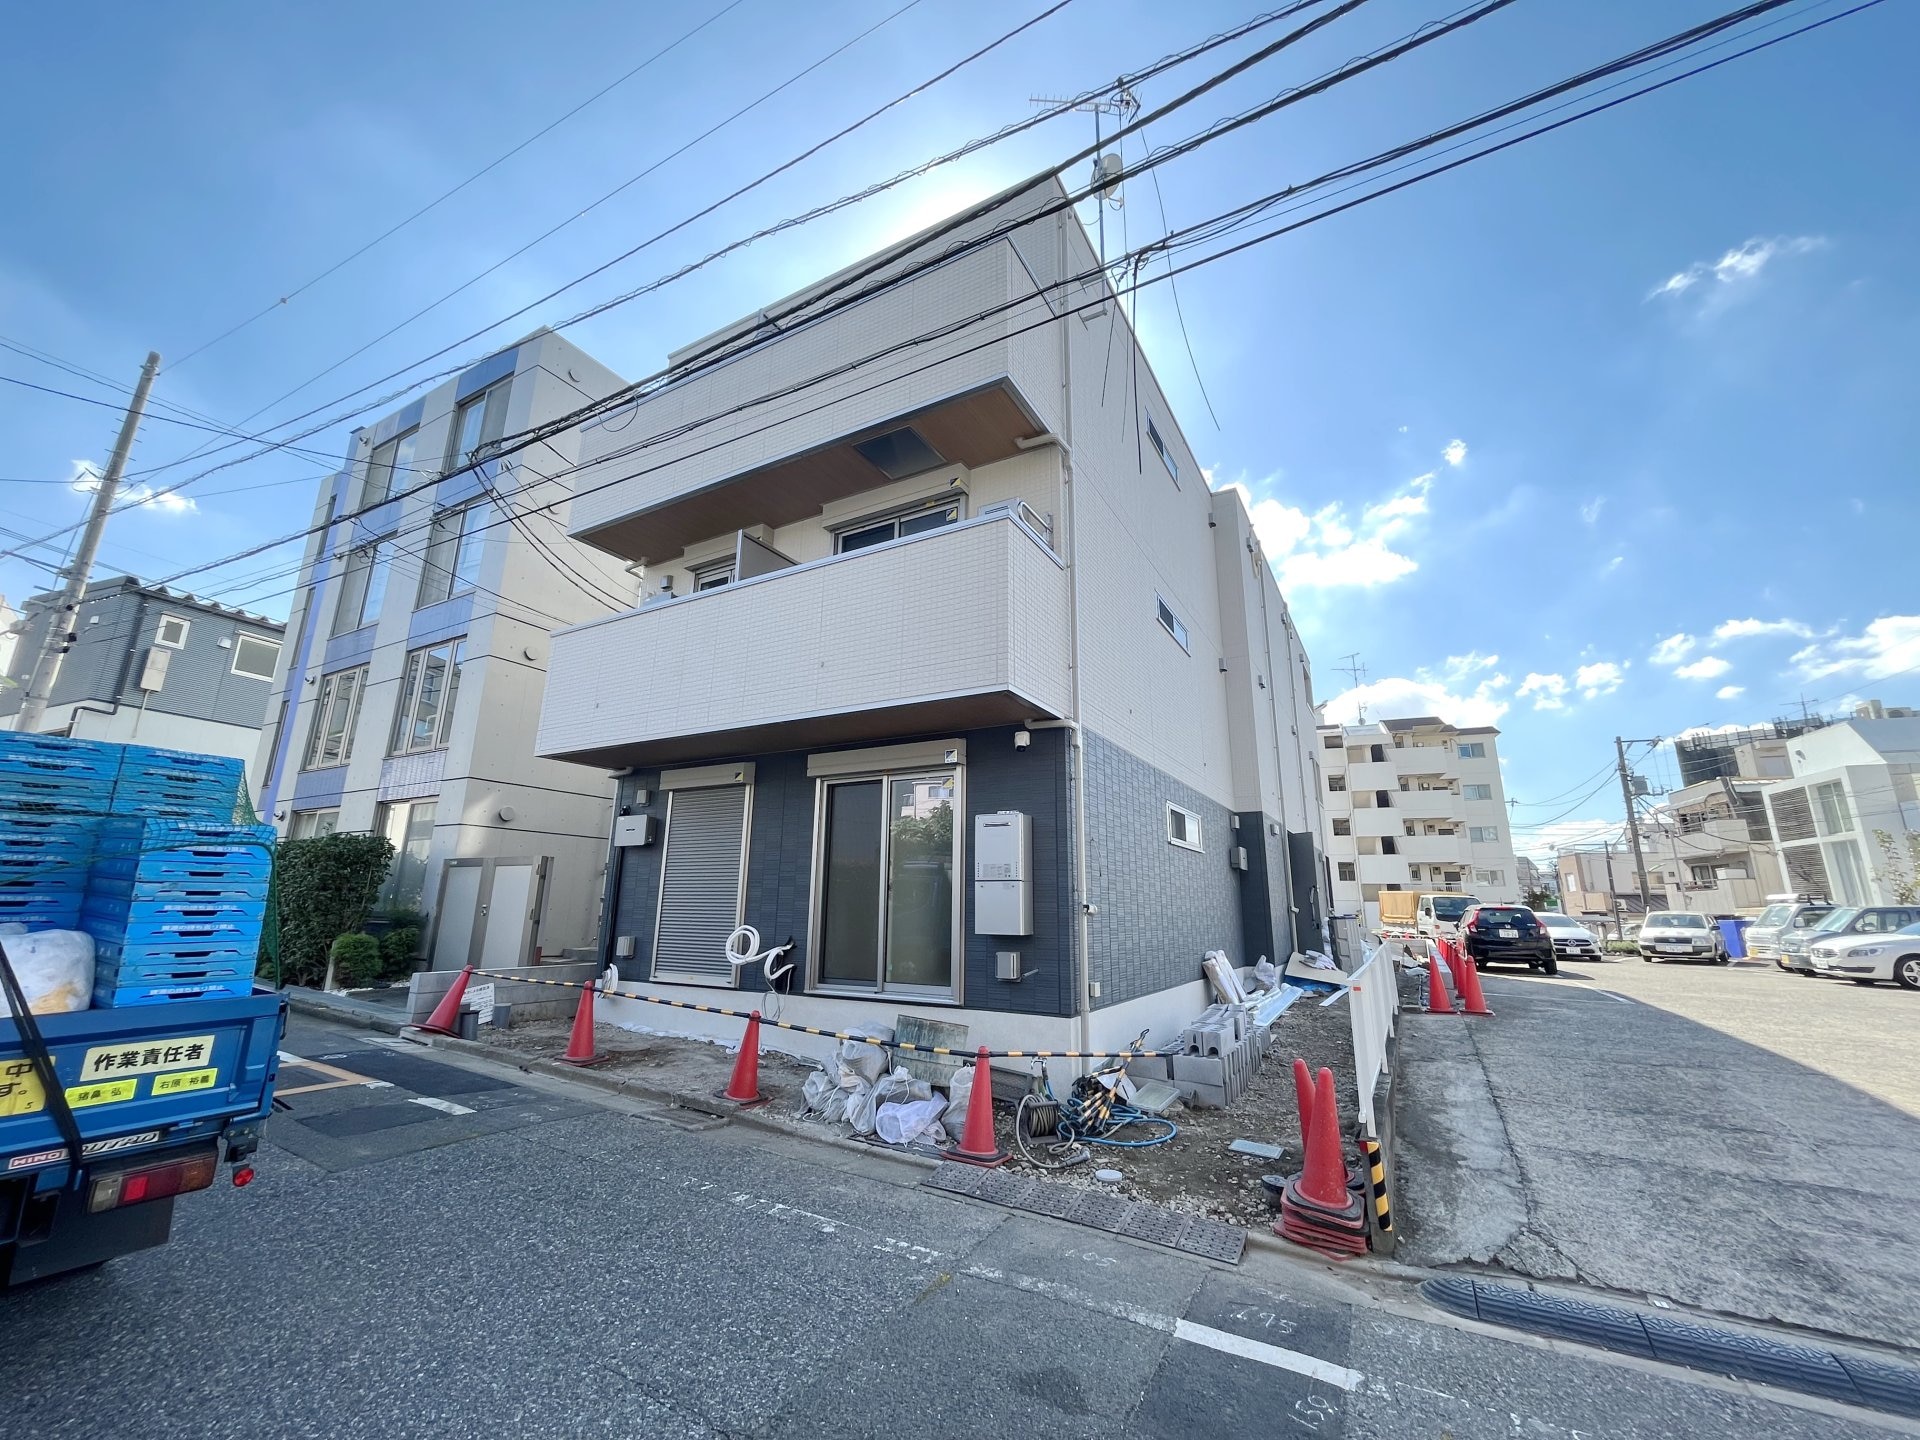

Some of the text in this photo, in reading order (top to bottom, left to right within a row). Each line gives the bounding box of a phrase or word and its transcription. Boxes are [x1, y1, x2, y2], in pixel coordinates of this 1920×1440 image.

[94, 1043, 205, 1073] 作業責任者
[13, 1151, 61, 1167] HINO
